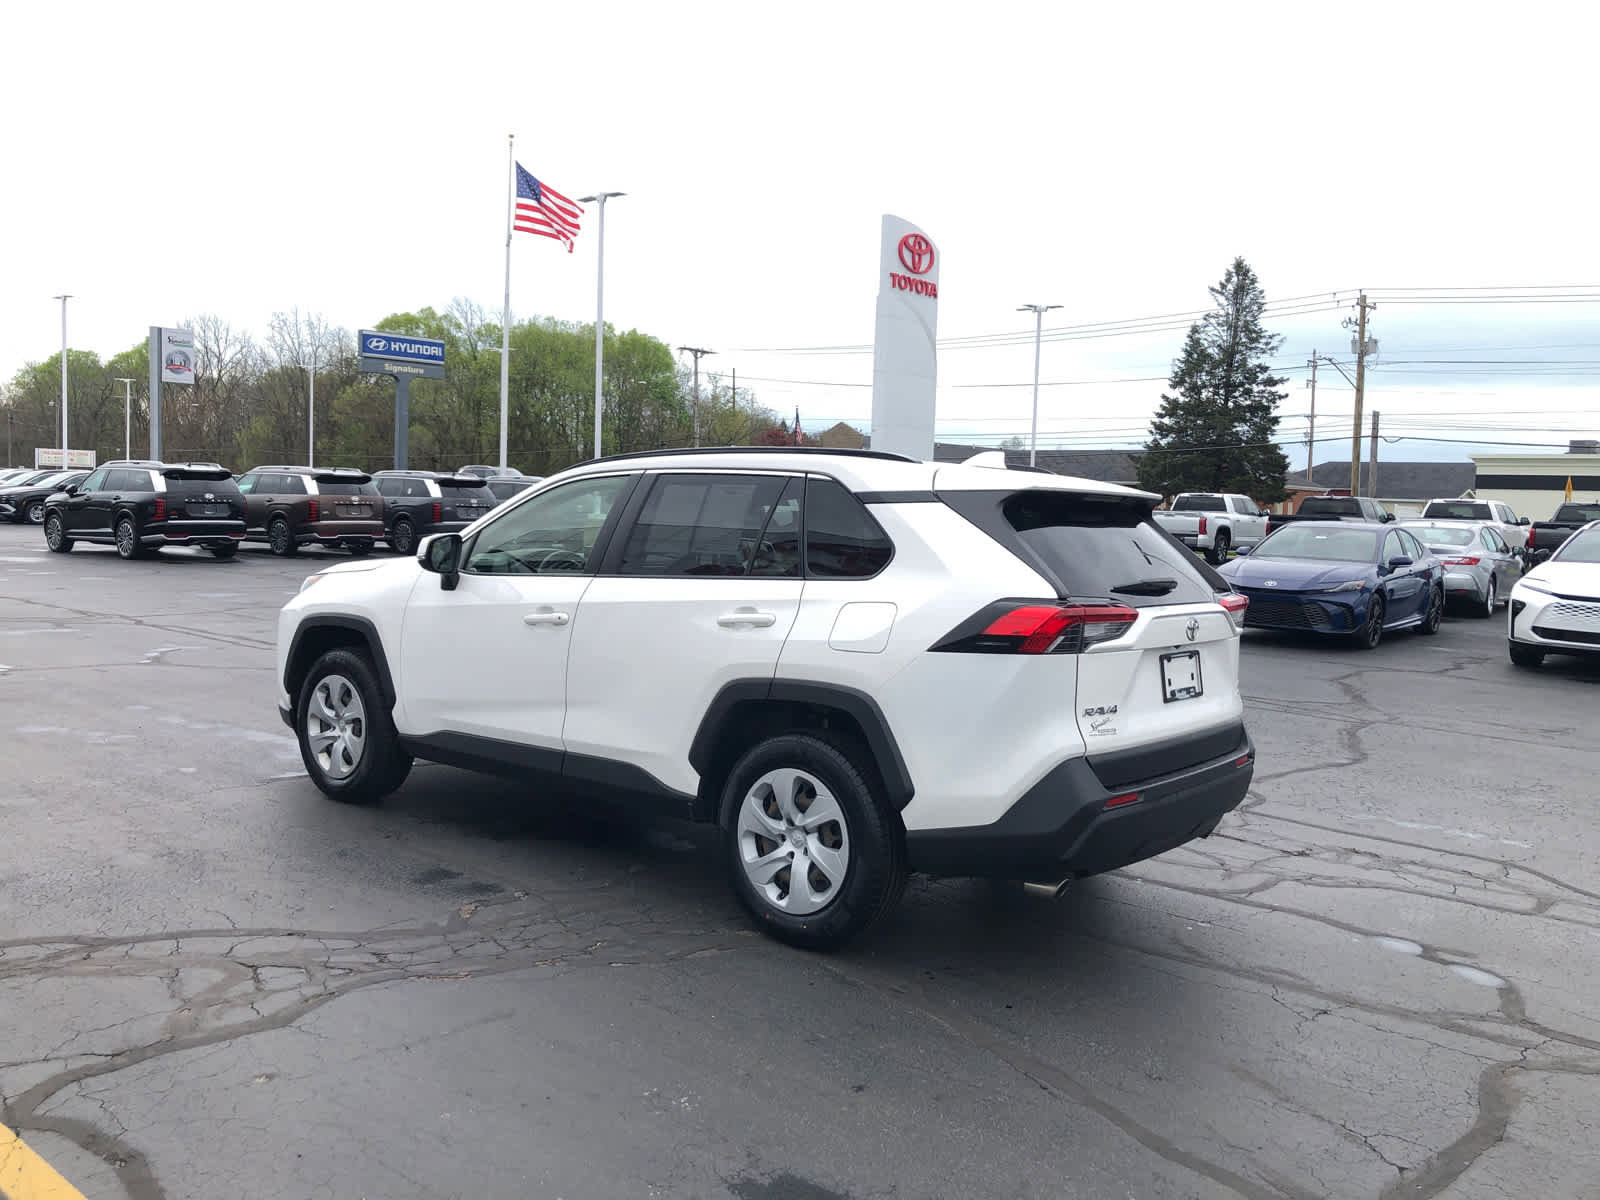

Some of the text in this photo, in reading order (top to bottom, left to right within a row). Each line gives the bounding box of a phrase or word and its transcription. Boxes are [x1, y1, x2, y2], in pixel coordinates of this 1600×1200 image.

[890, 272, 938, 298] TOYOTA
[391, 341, 442, 356] HYUNDAI
[384, 363, 425, 375] Signature
[1082, 704, 1118, 718] RAV4
